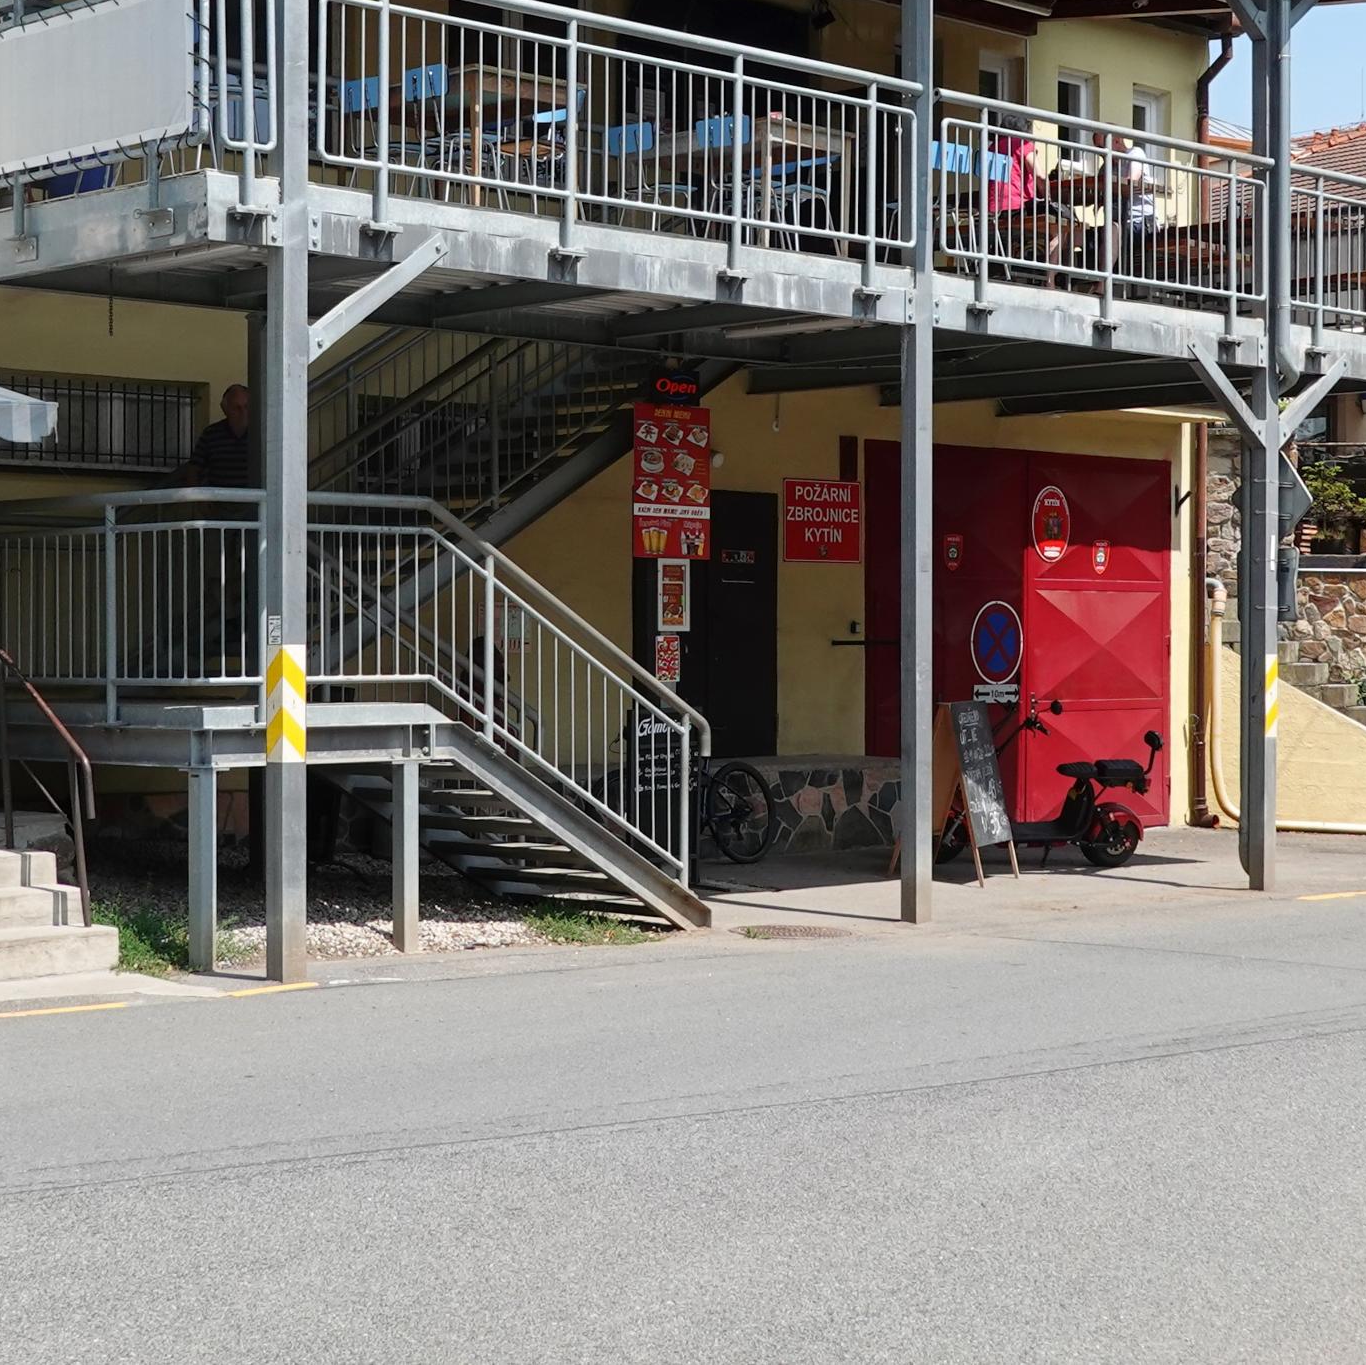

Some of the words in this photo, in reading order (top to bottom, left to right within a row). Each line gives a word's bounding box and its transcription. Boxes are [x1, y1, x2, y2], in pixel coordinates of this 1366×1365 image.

[655, 377, 698, 394] Open
[795, 483, 852, 503] POŽÁRNÍ
[786, 506, 859, 523] ZBROJNICE
[804, 525, 842, 543] KYTÍN
[991, 689, 1005, 699] 10m
